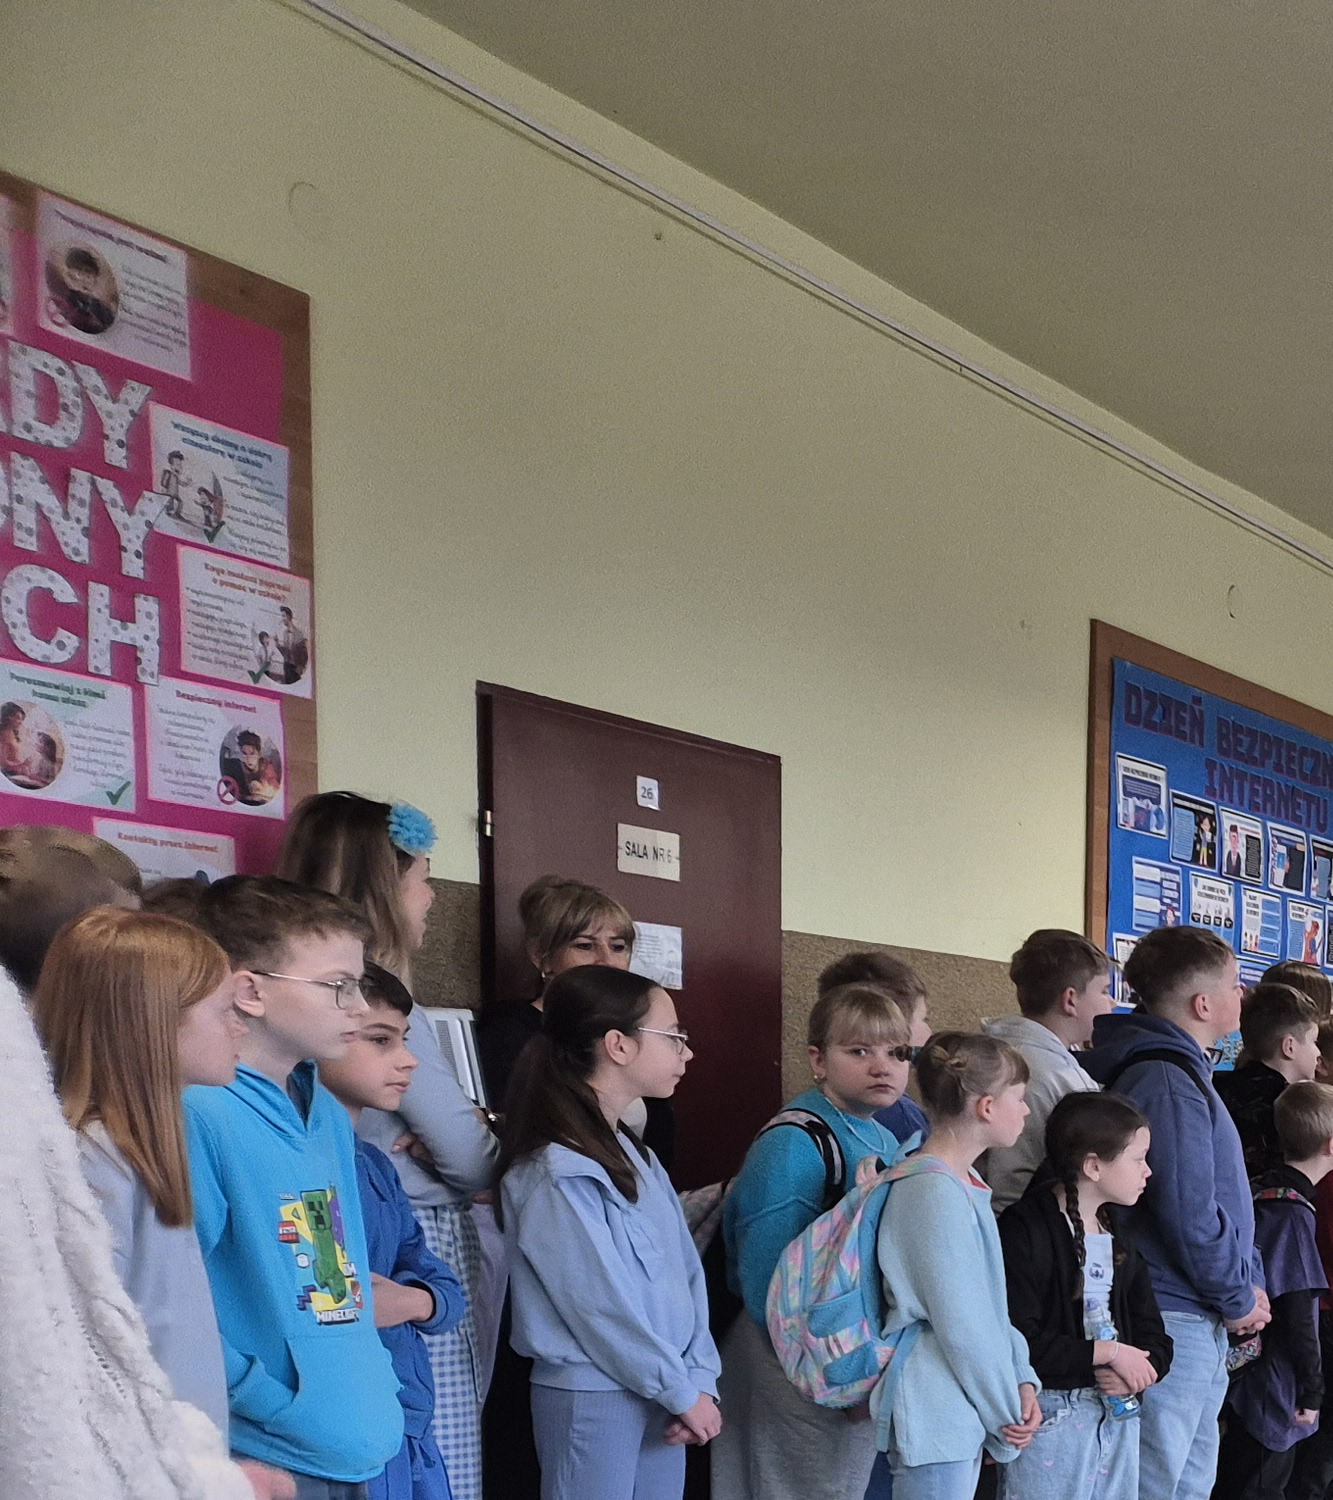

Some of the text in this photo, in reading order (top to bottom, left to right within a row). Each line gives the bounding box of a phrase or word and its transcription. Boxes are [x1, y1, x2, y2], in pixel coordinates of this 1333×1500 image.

[0, 340, 153, 469] DY
[0, 451, 171, 580] NY
[175, 689, 257, 713] Bezpieczny internet
[1123, 681, 1206, 749] DZIEŃ
[641, 786, 653, 800] 26
[1204, 757, 1329, 834] INTERNETU
[625, 841, 672, 864] SALA NR 6
